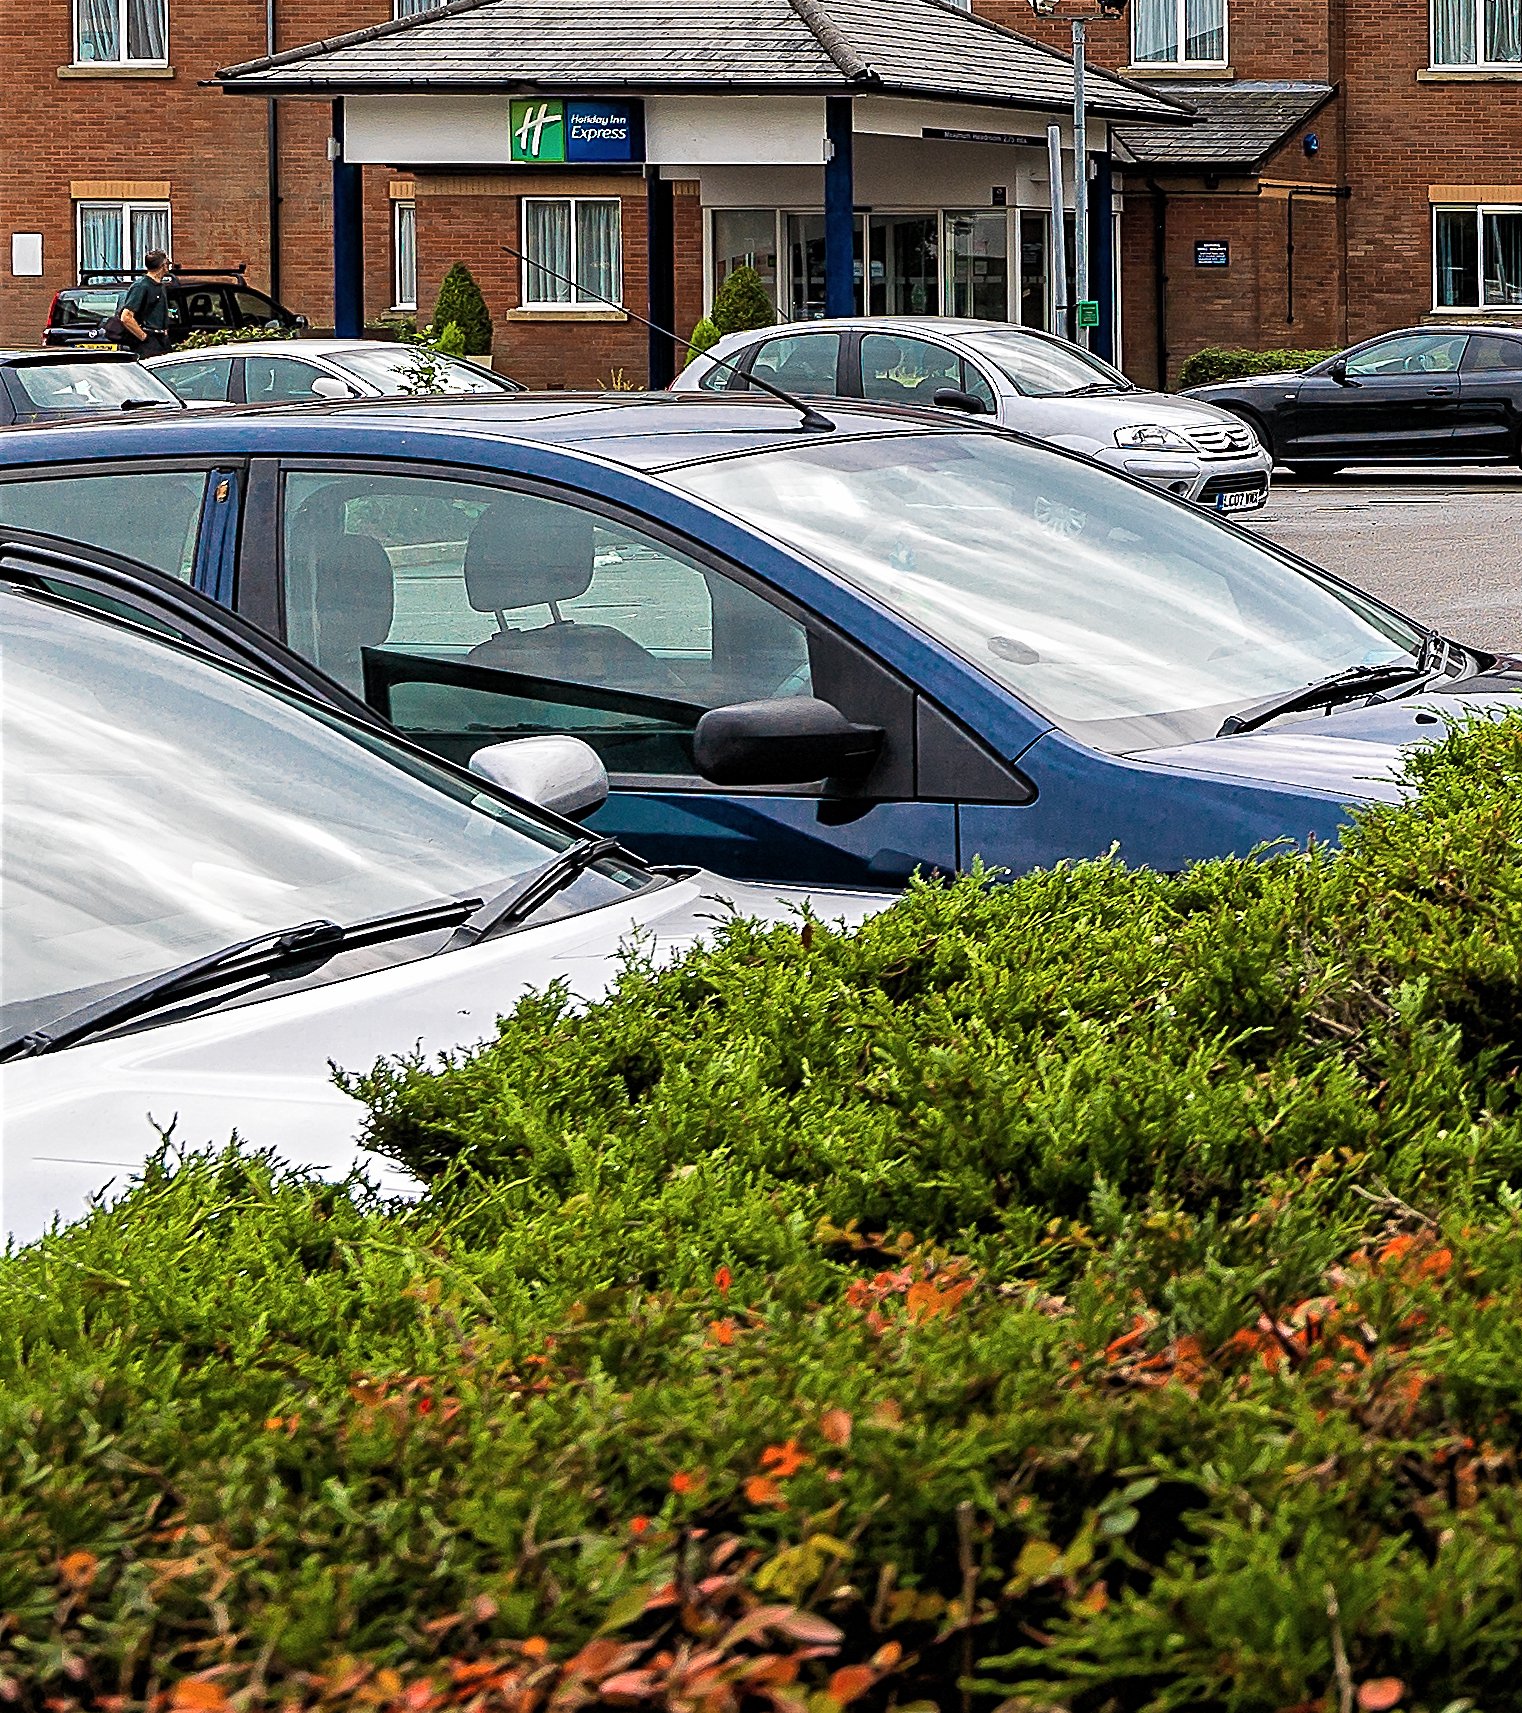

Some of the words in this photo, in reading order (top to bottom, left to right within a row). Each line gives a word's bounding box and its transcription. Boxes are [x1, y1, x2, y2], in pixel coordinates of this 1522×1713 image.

[571, 114, 609, 126] Holiday
[610, 114, 627, 124] Inn
[571, 125, 627, 142] Express
